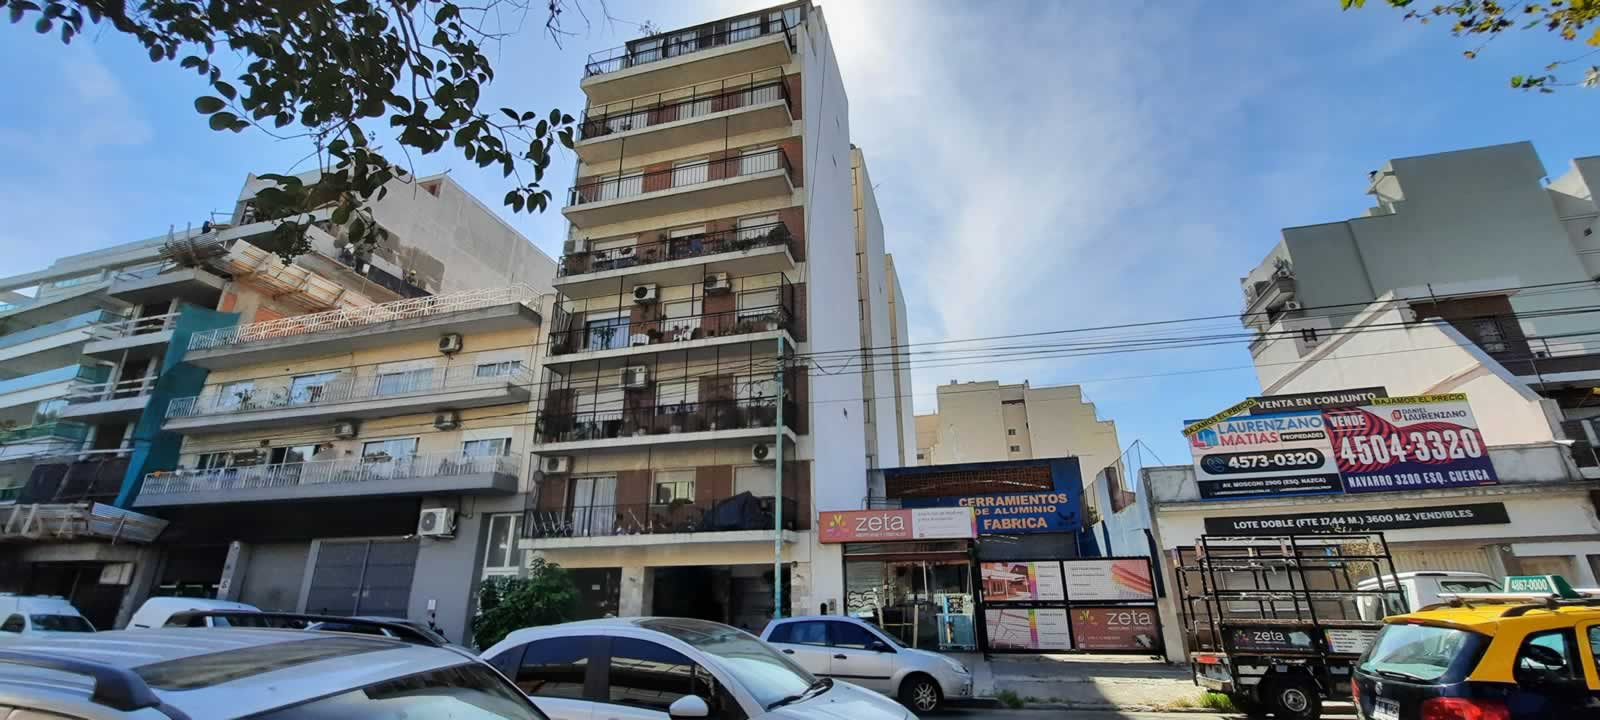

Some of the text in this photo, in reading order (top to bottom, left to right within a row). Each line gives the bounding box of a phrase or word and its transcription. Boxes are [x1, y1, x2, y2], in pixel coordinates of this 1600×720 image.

[1229, 399, 1255, 416] PRECIO
[1258, 391, 1376, 409] VENTA EN CONJUNTO
[1374, 396, 1417, 406] BAJAMOS
[1431, 393, 1465, 402] PRECIO
[1330, 414, 1366, 427] VENDE
[1403, 410, 1466, 421] LAURENZANO
[1217, 416, 1323, 435] LAURENZANO
[1219, 432, 1279, 447] MATIAS
[1282, 432, 1324, 441] PROPIEDADES
[1340, 428, 1482, 466] 4504-3320
[1228, 451, 1318, 469] 4573-0320
[1348, 469, 1490, 488] NAVARRO 3200 ESQ. CUENCA
[958, 493, 1068, 507] CERRAMIENTOS
[994, 505, 1056, 514] ALUMINIO
[855, 512, 905, 532] zeta
[983, 517, 1048, 530] FABRICA
[1233, 520, 1259, 529] LOTE
[1260, 519, 1294, 528] DOBLE
[1296, 518, 1319, 528] (FTE
[1366, 514, 1393, 523] 3600
[1395, 513, 1412, 522] M2
[1412, 509, 1474, 521] VENDIBLES
[1105, 609, 1152, 626] zeta
[1252, 629, 1285, 641] zeta
